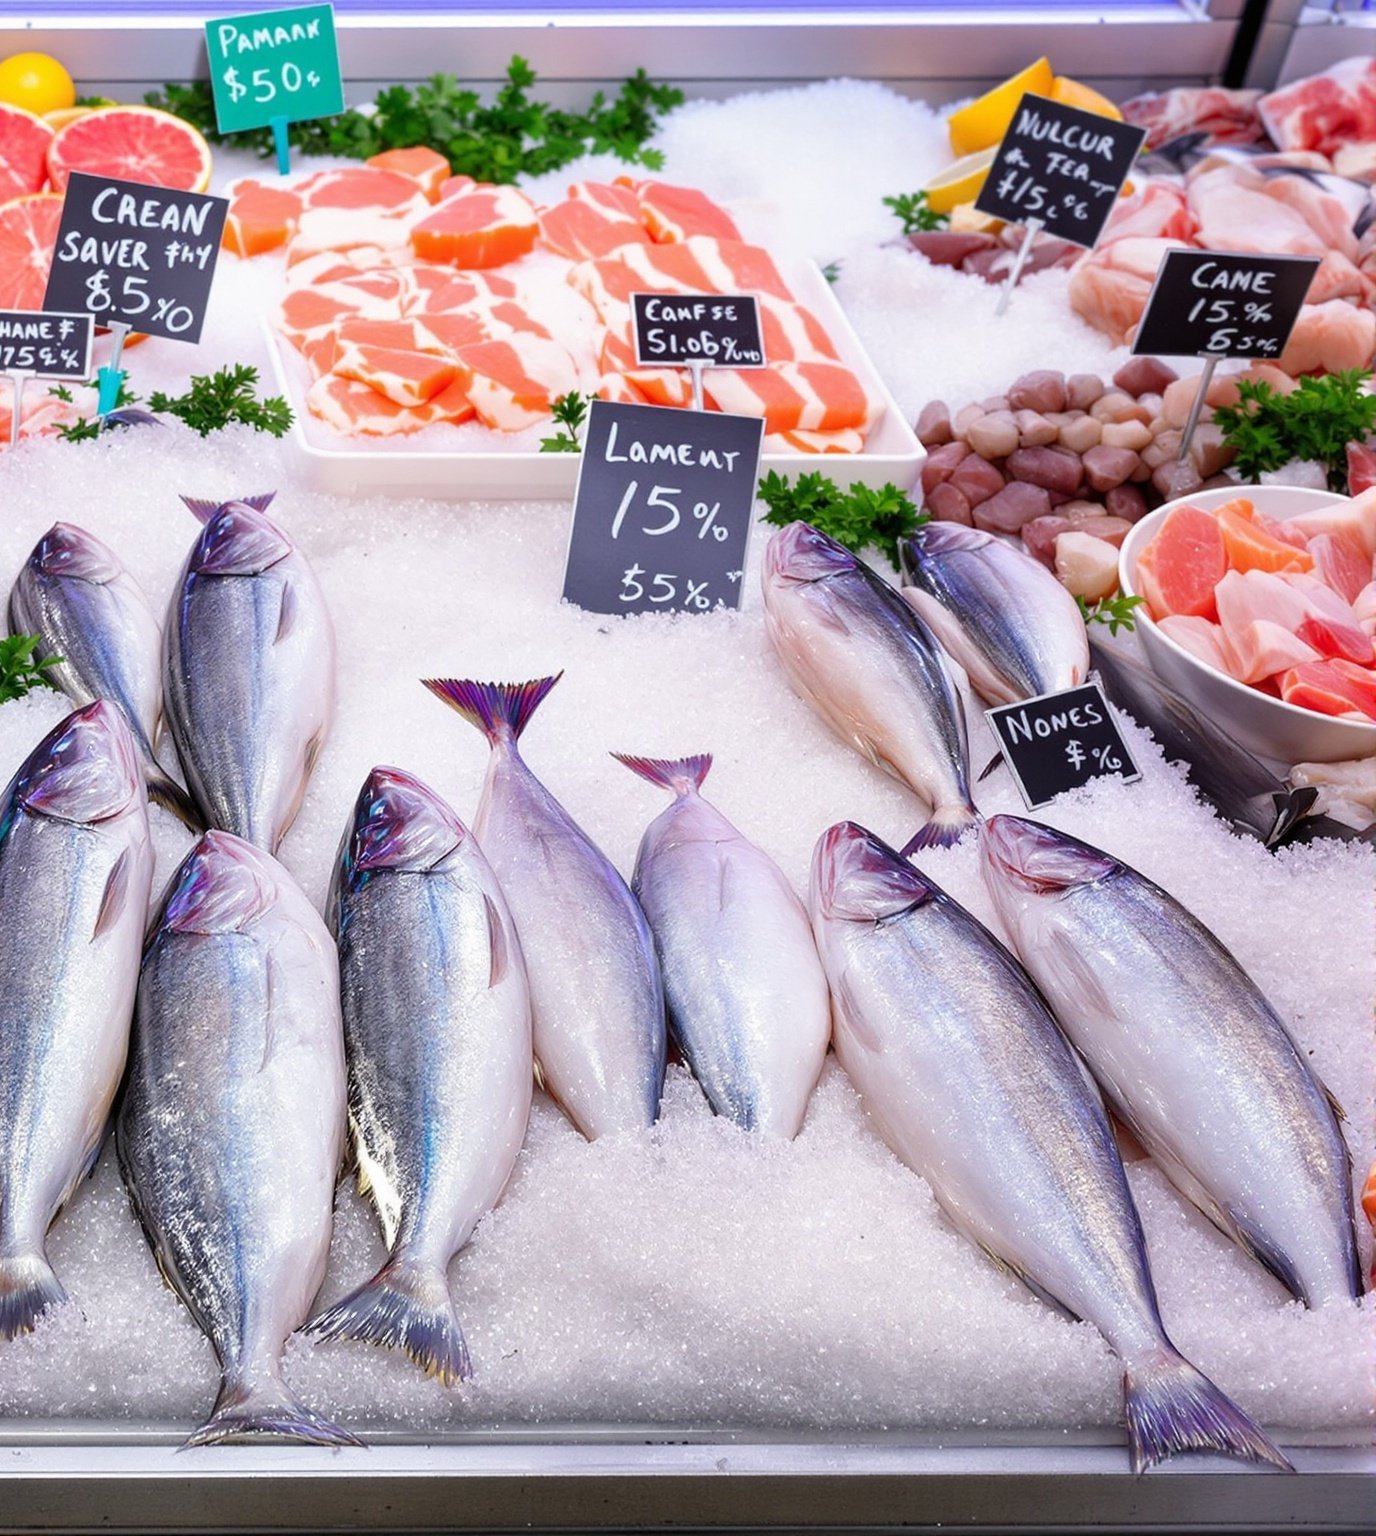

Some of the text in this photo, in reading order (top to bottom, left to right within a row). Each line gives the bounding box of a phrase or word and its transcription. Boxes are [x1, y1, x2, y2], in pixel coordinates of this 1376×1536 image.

[91, 187, 214, 236] CREAN
[58, 231, 150, 271] SAVER
[1191, 262, 1277, 294] CAME
[1005, 703, 1103, 745] NONES
